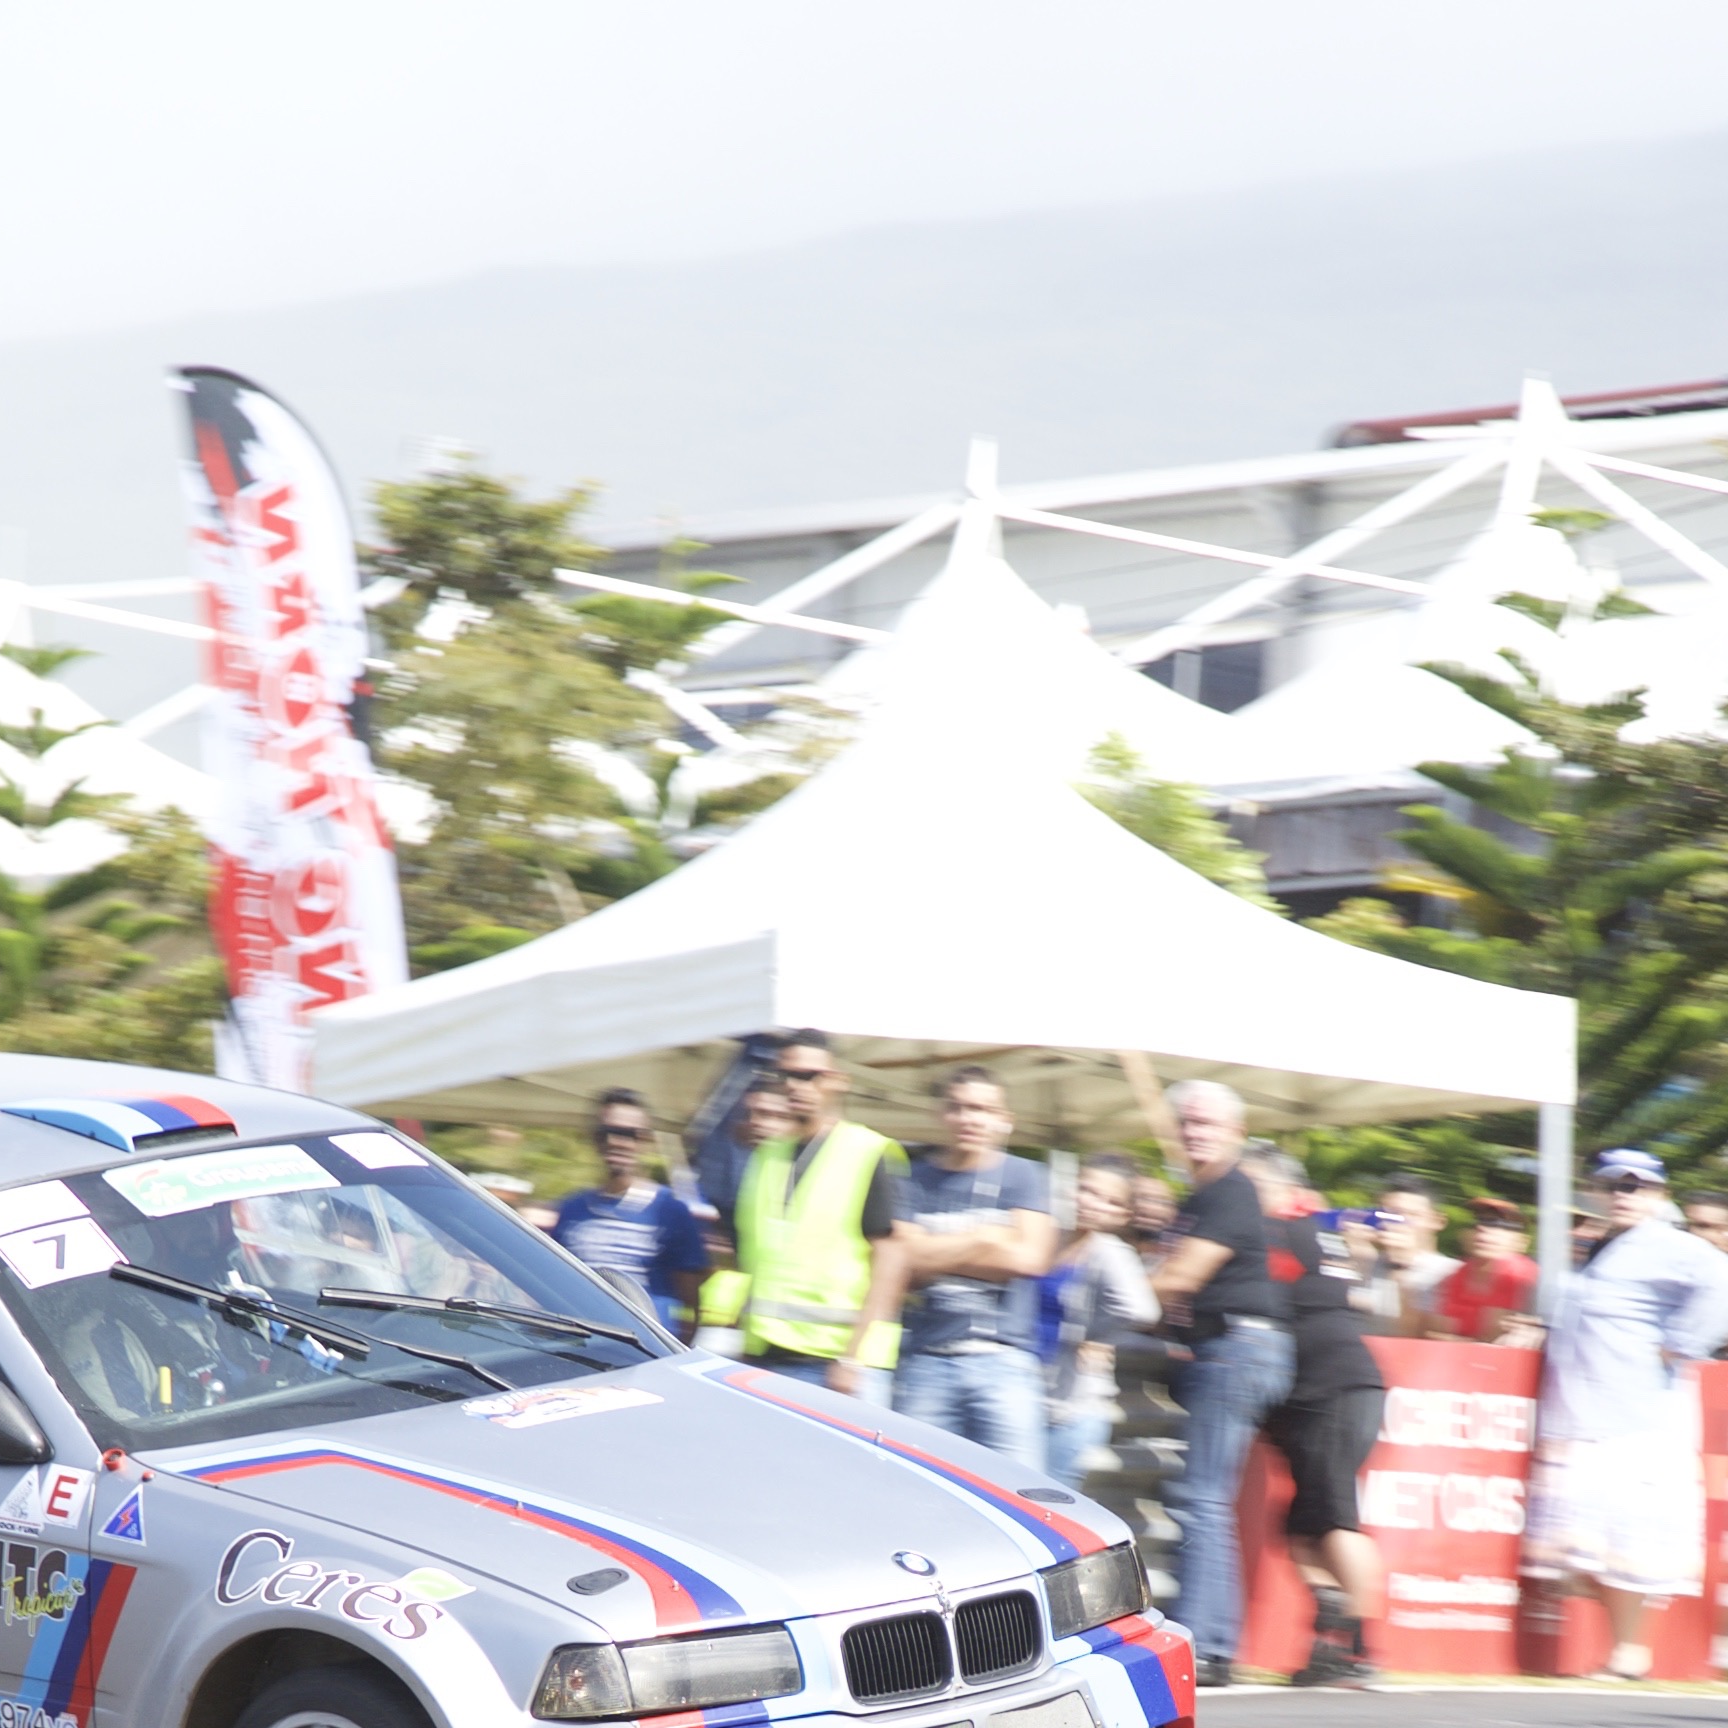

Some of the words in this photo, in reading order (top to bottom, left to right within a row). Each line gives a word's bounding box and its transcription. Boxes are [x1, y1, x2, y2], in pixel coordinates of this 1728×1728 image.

[32, 1233, 67, 1271] 7
[46, 1474, 79, 1519] E
[215, 1528, 445, 1642] Ceres
